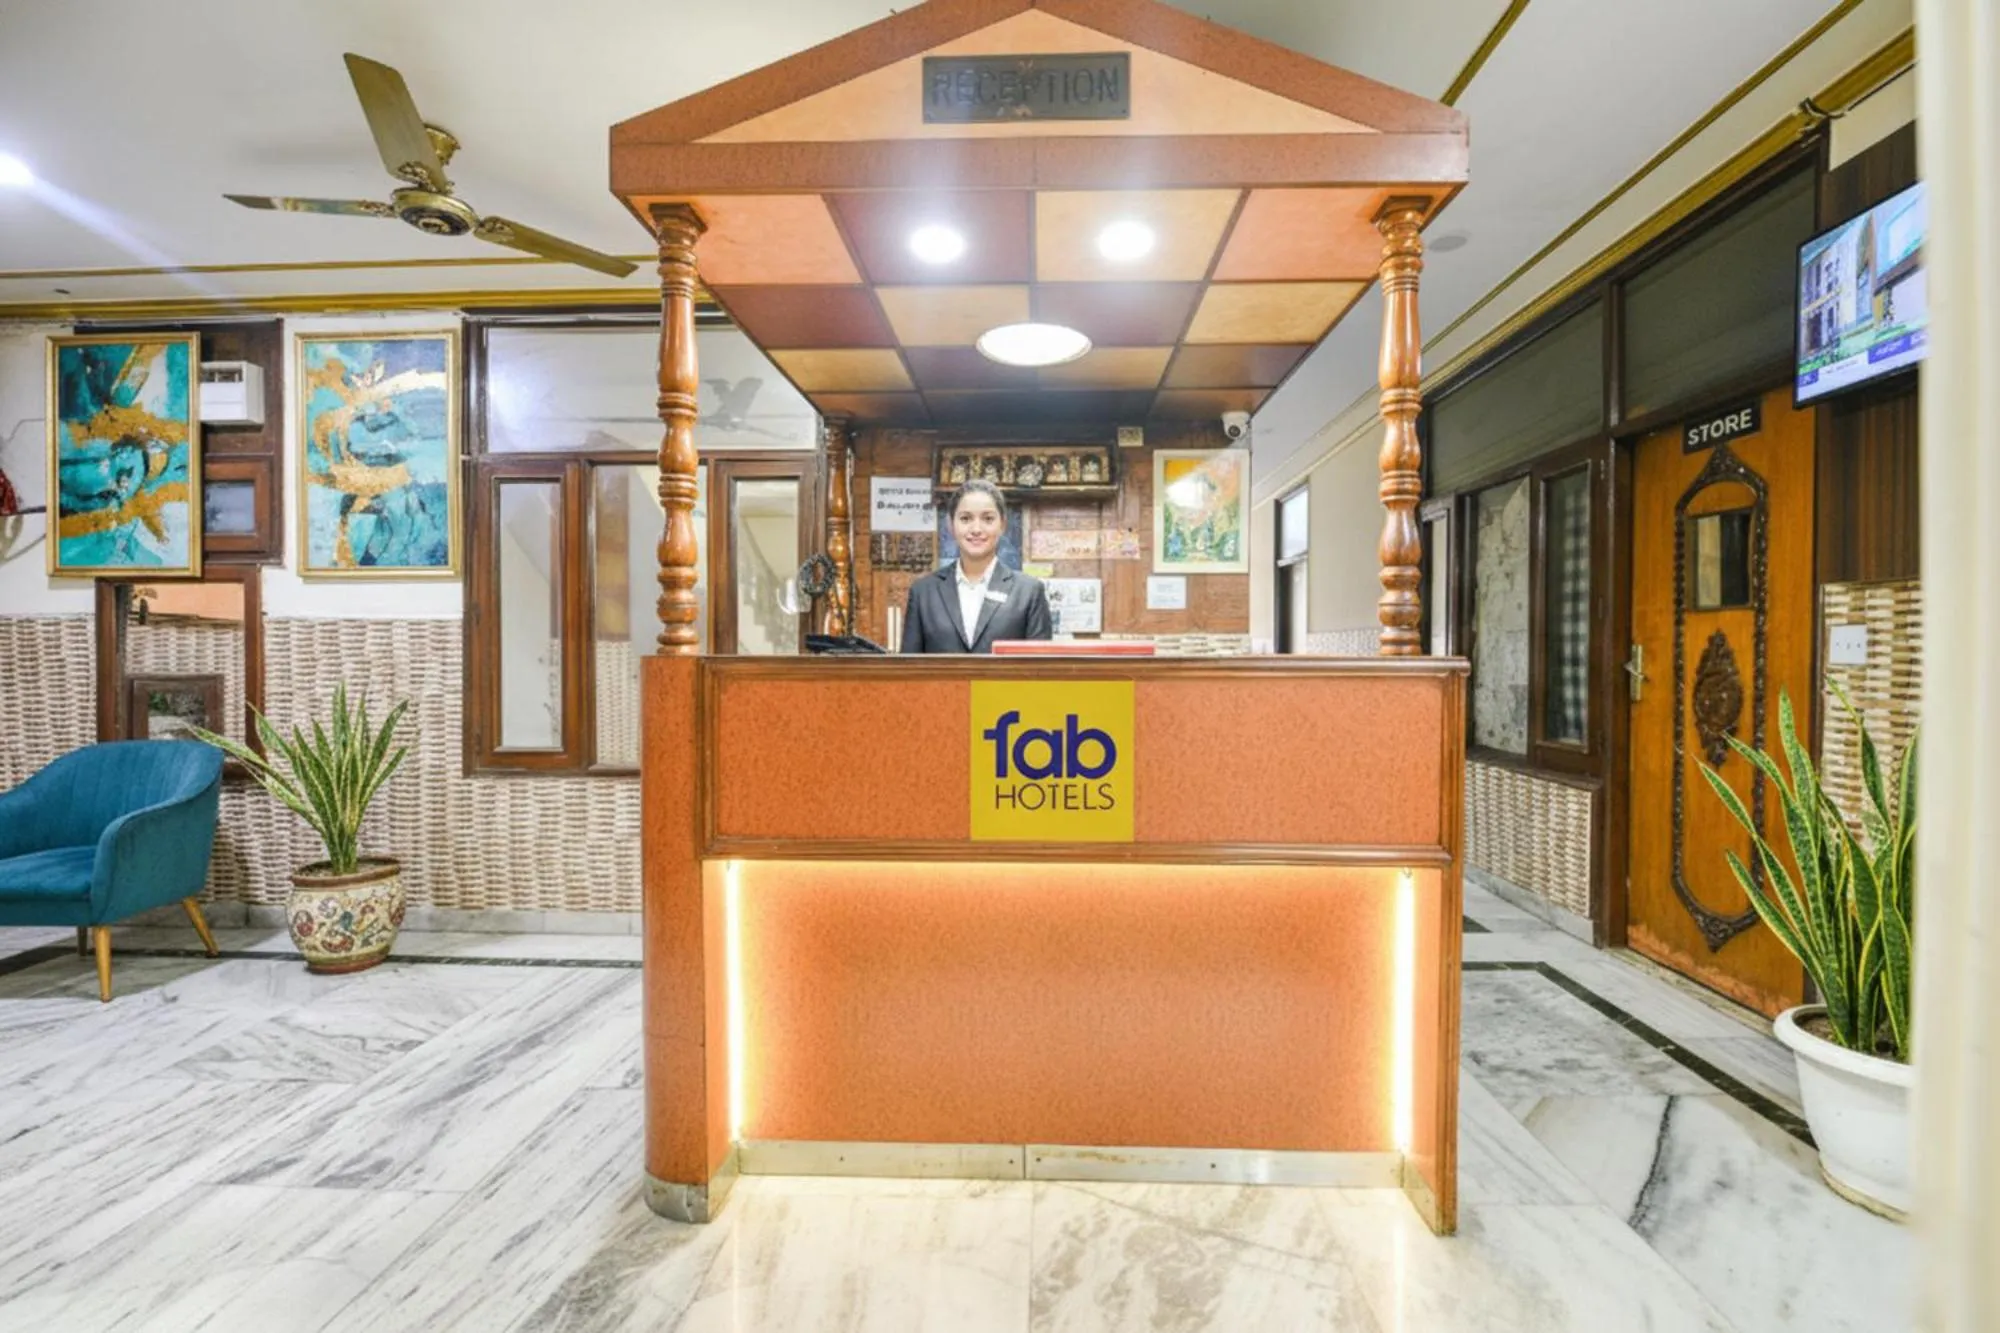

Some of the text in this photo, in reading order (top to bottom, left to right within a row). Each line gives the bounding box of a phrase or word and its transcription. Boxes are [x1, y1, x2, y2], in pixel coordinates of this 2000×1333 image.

[932, 65, 1121, 106] RECEPTION
[1687, 408, 1753, 445] STORE
[983, 710, 1117, 780] fab
[995, 783, 1115, 811] HOTELS
